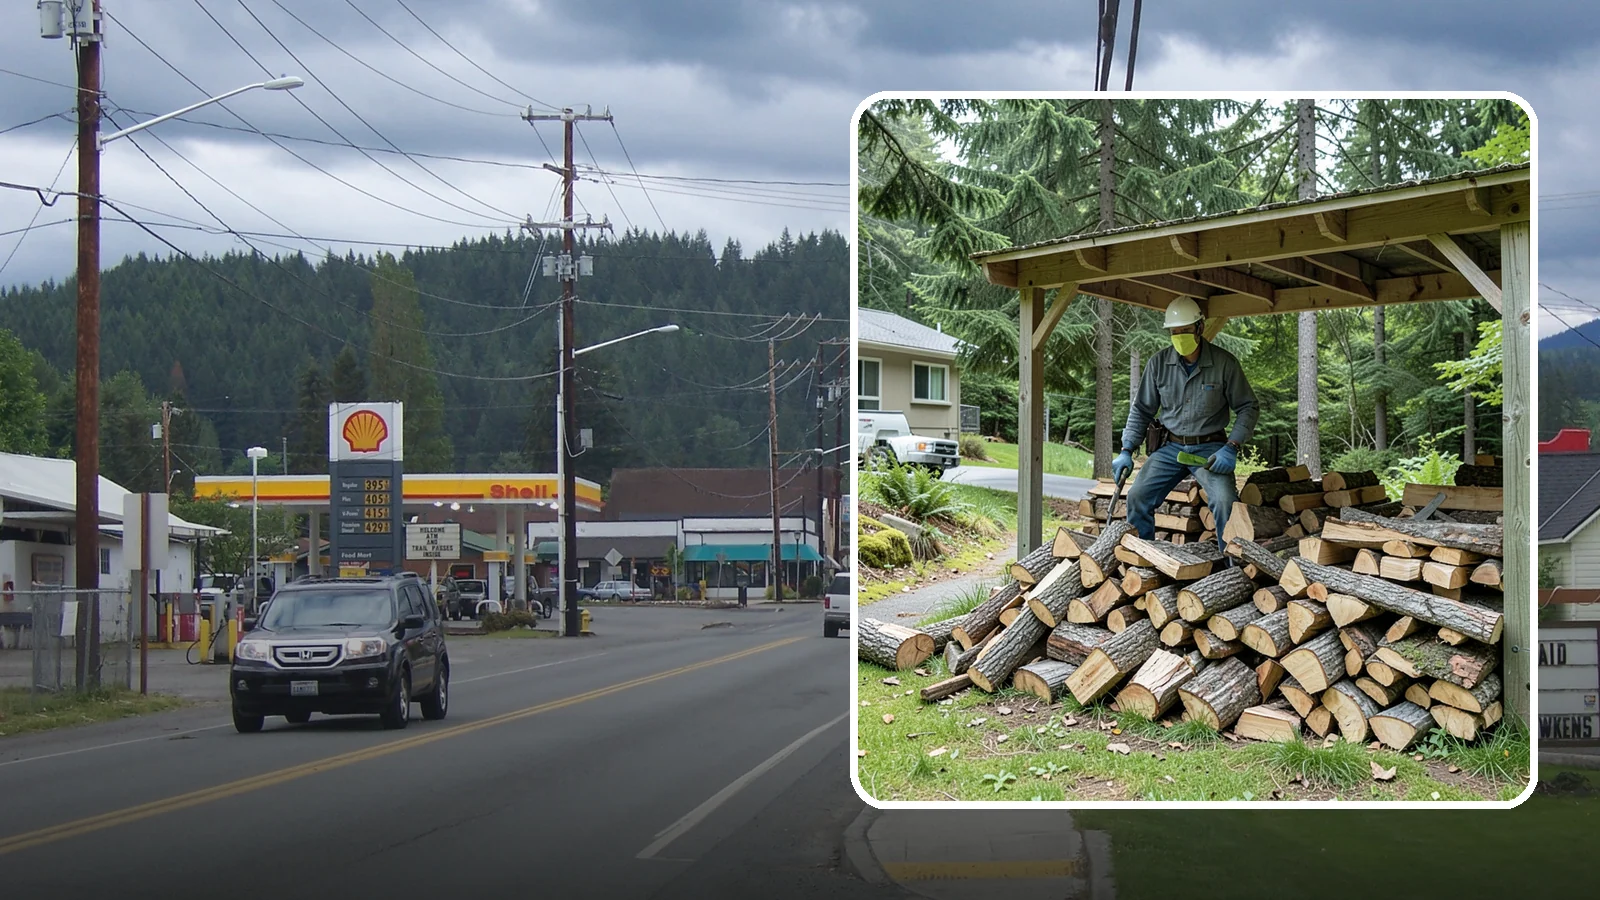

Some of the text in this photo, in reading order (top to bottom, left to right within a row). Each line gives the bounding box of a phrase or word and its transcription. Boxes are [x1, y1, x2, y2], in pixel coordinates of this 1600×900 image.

[365, 480, 383, 490] 395
[490, 484, 547, 499] Shell
[365, 494, 383, 504] 405
[365, 508, 383, 518] 415
[365, 522, 383, 532] 429
